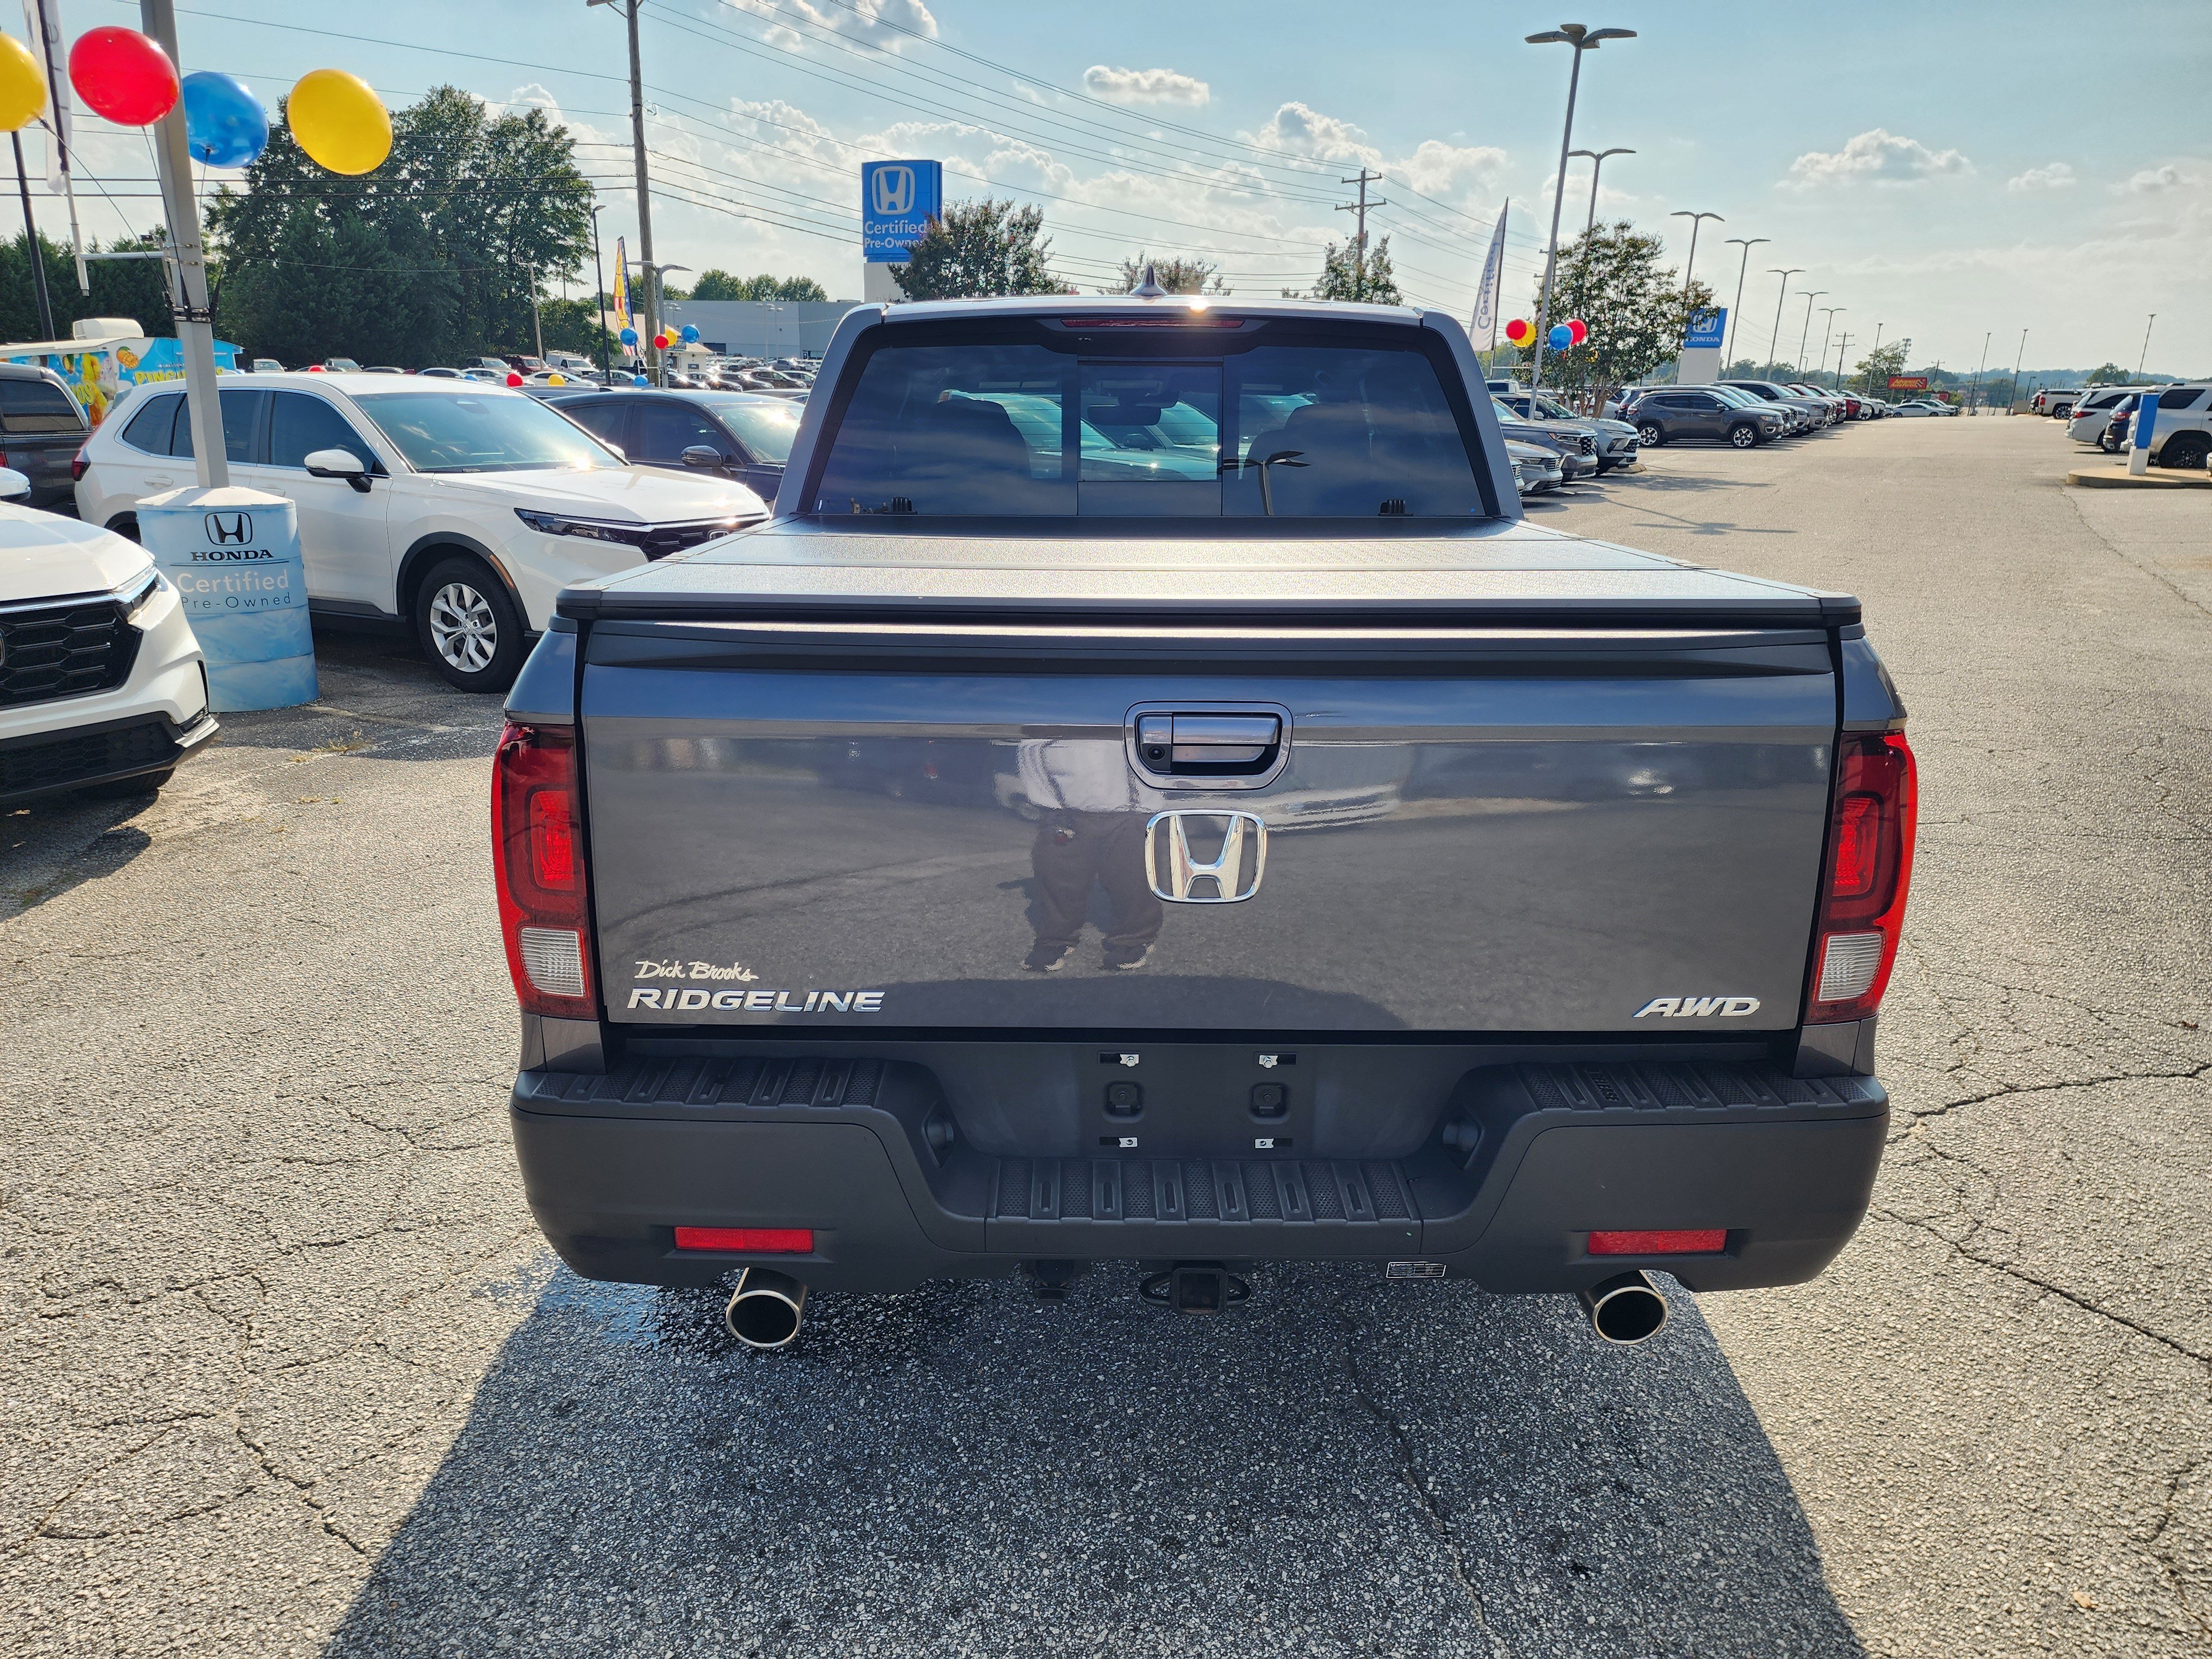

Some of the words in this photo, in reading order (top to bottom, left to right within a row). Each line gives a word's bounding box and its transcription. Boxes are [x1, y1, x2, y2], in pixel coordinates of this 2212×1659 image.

[864, 220, 927, 235] Certified
[864, 237, 920, 248] Pre-Own
[190, 549, 274, 561] HONDA
[177, 568, 289, 593] Certified
[181, 592, 291, 608] Pre-Owned
[634, 959, 686, 979] Dick
[687, 961, 760, 982] Brooks
[627, 988, 886, 1013] RIDGELINE
[1632, 997, 1761, 1018] AWD
